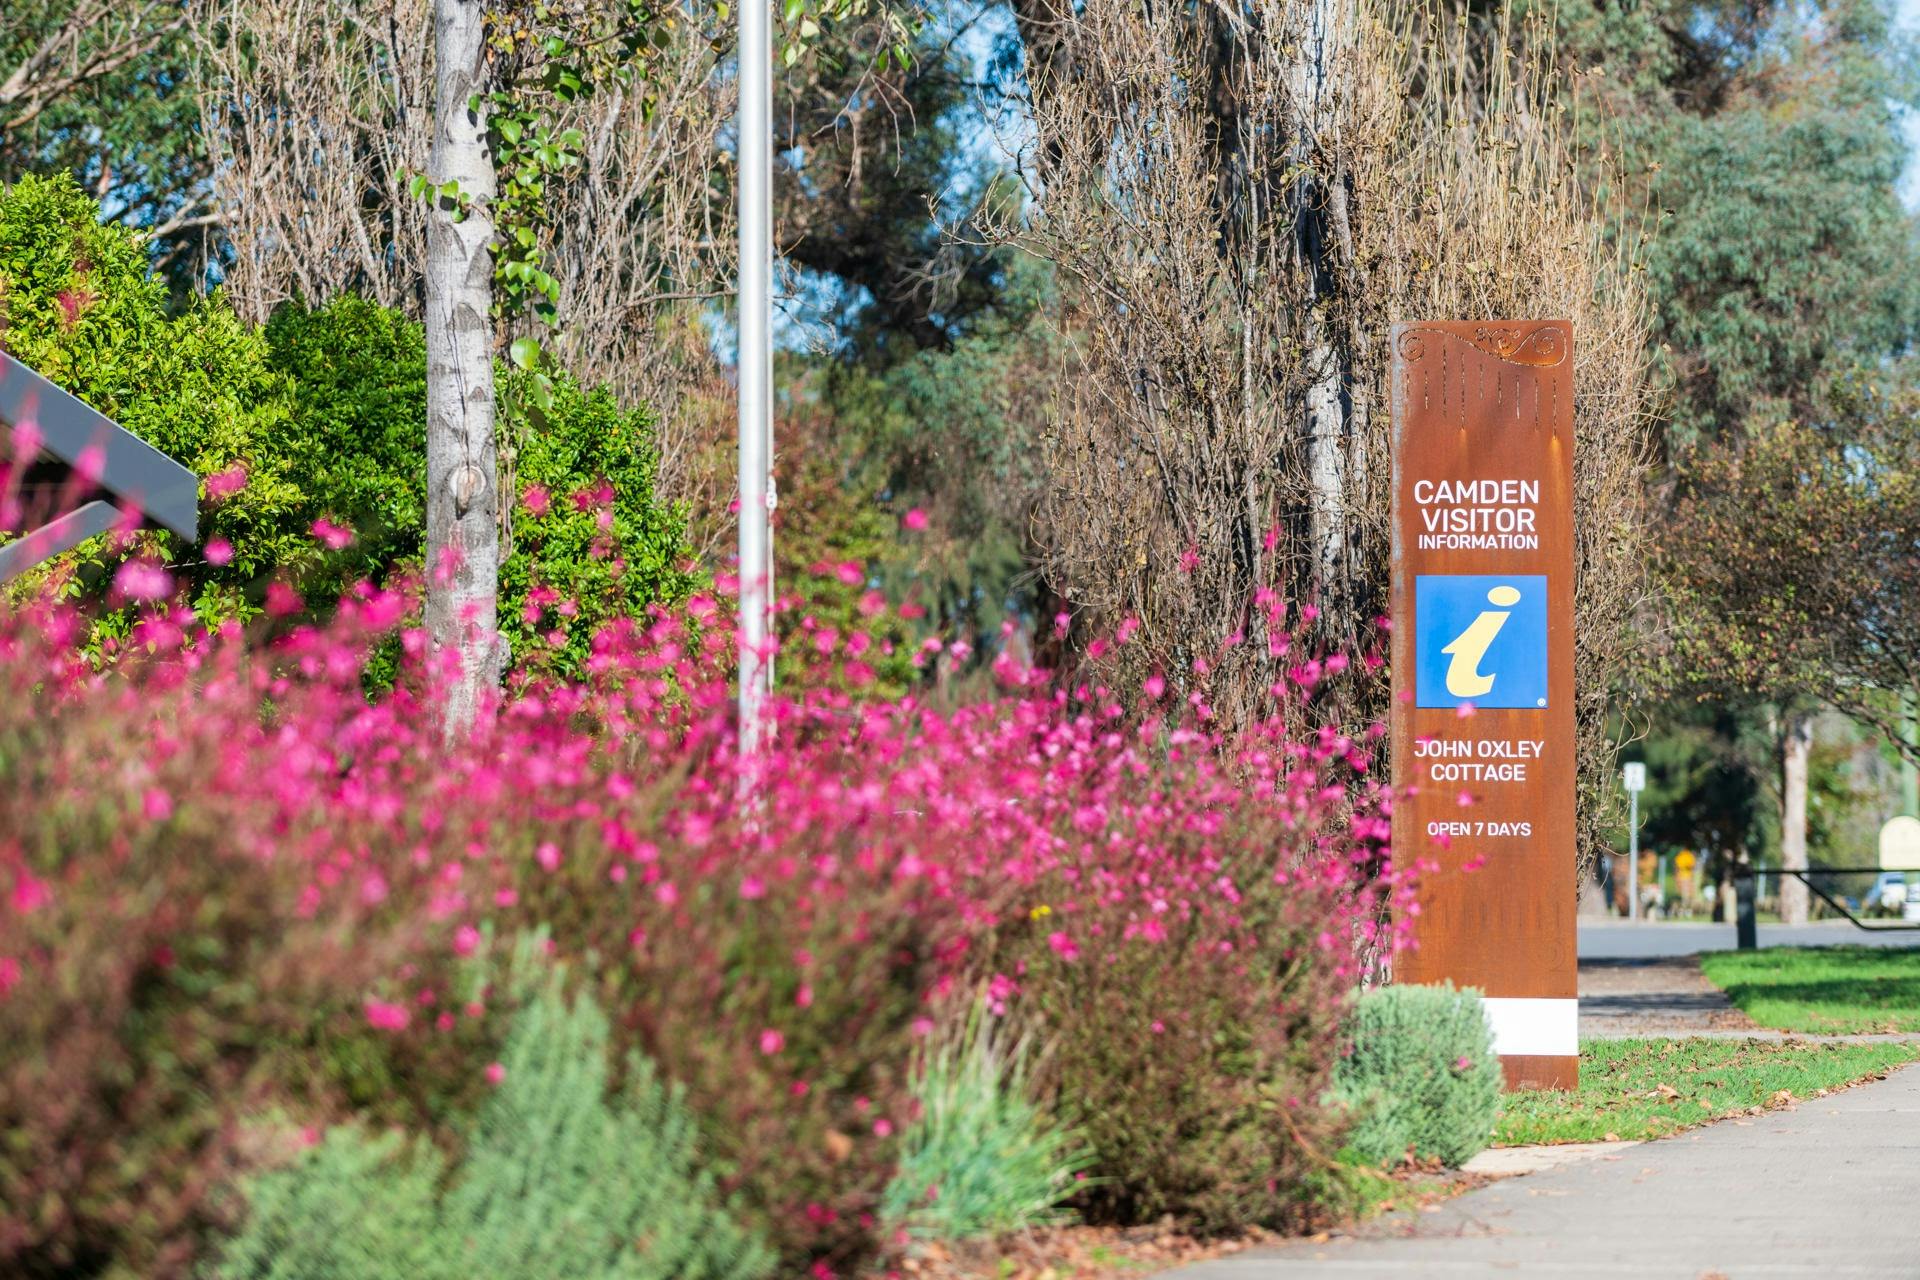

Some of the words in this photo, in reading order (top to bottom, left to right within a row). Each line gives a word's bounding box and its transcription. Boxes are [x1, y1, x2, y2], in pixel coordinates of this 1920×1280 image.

[1414, 480, 1539, 504] CAMDEN
[1421, 508, 1535, 532] VISITOR
[1418, 534, 1538, 549] INFORMATION
[1414, 740, 1472, 758] JOHN
[1477, 740, 1545, 758] OXLEY
[1431, 764, 1526, 781] COTTAGE
[1427, 822, 1471, 836] OPEN
[1475, 822, 1485, 836] 7
[1487, 822, 1531, 836] DAYS
